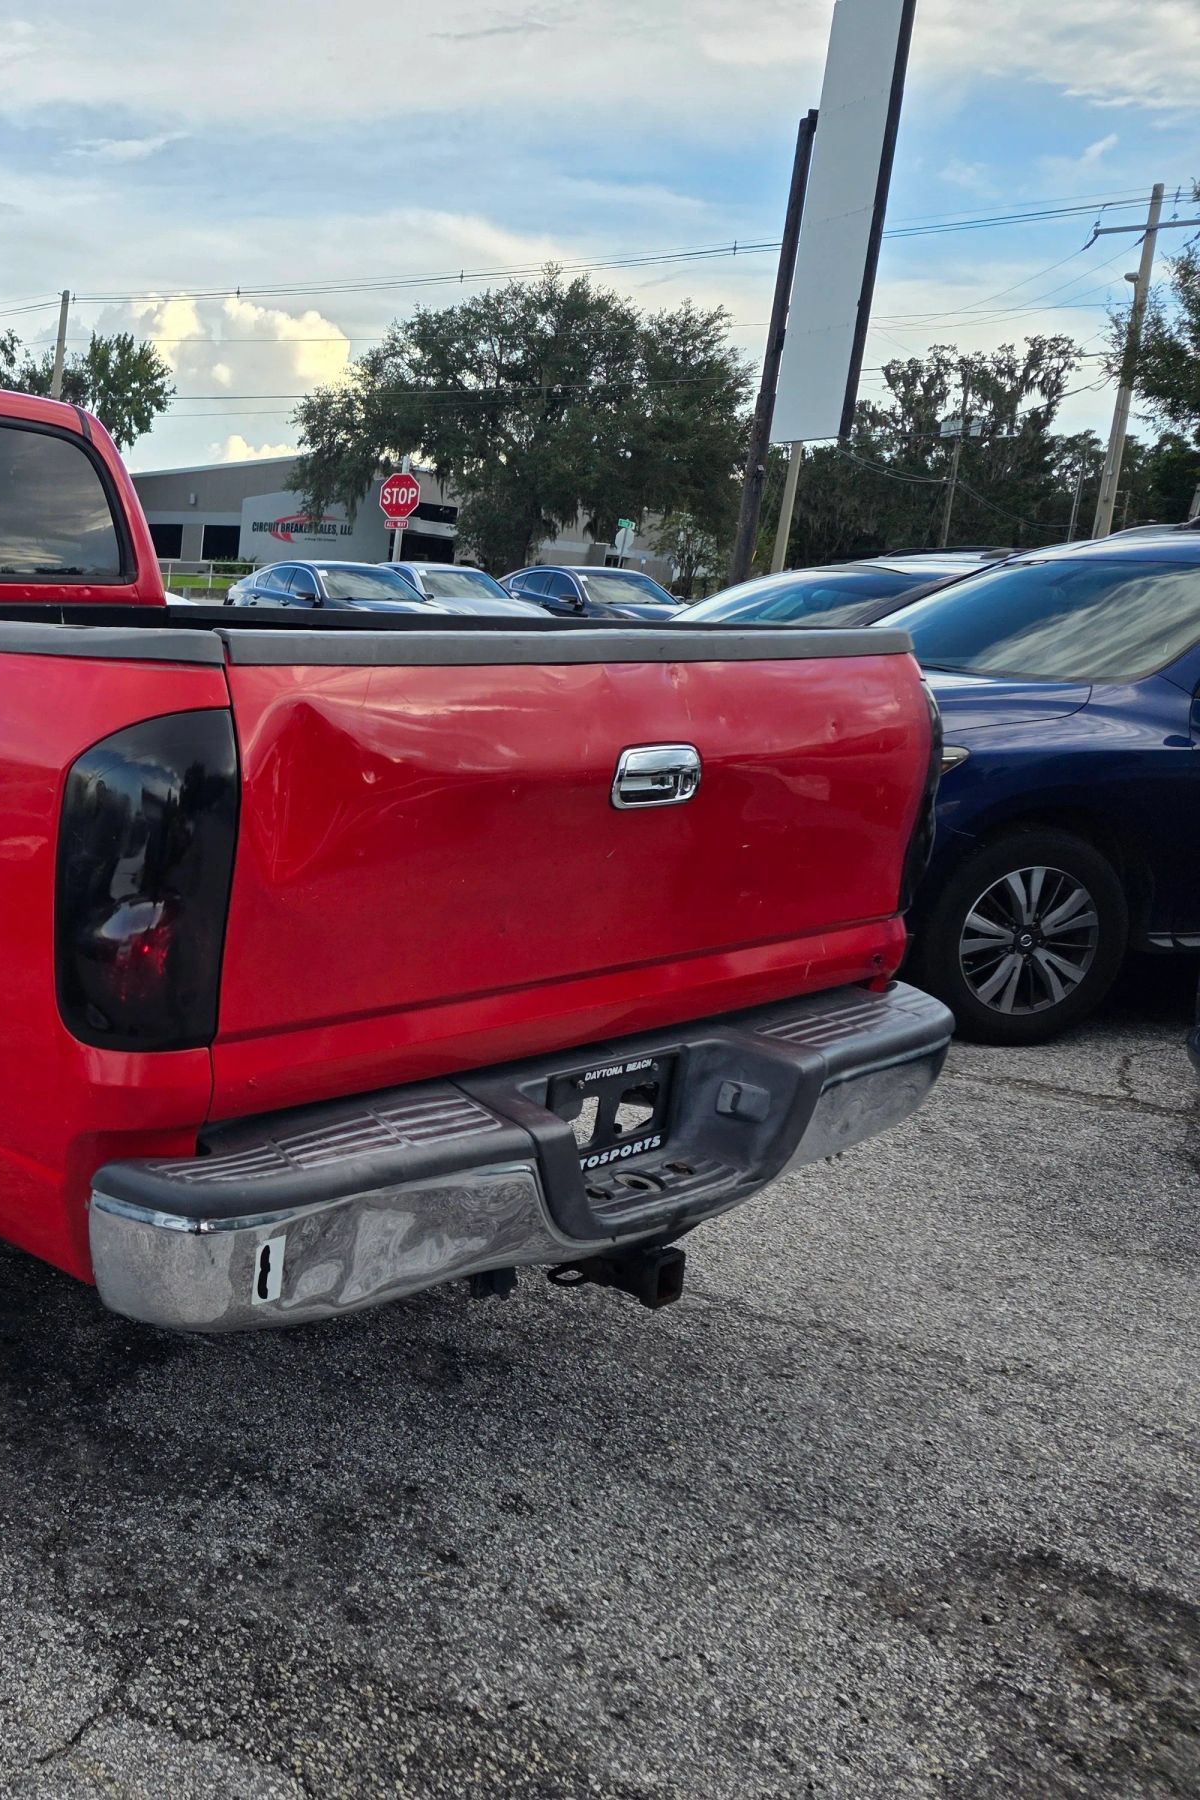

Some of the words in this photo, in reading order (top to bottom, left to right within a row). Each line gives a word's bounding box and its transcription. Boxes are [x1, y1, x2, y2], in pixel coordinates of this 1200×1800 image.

[383, 487, 417, 504] STOP
[252, 521, 279, 533] CIRCUIT
[314, 522, 338, 536] ALES,
[340, 524, 352, 535] LLC
[585, 1066, 623, 1081] DAYTONA
[626, 1059, 652, 1072] BEACH
